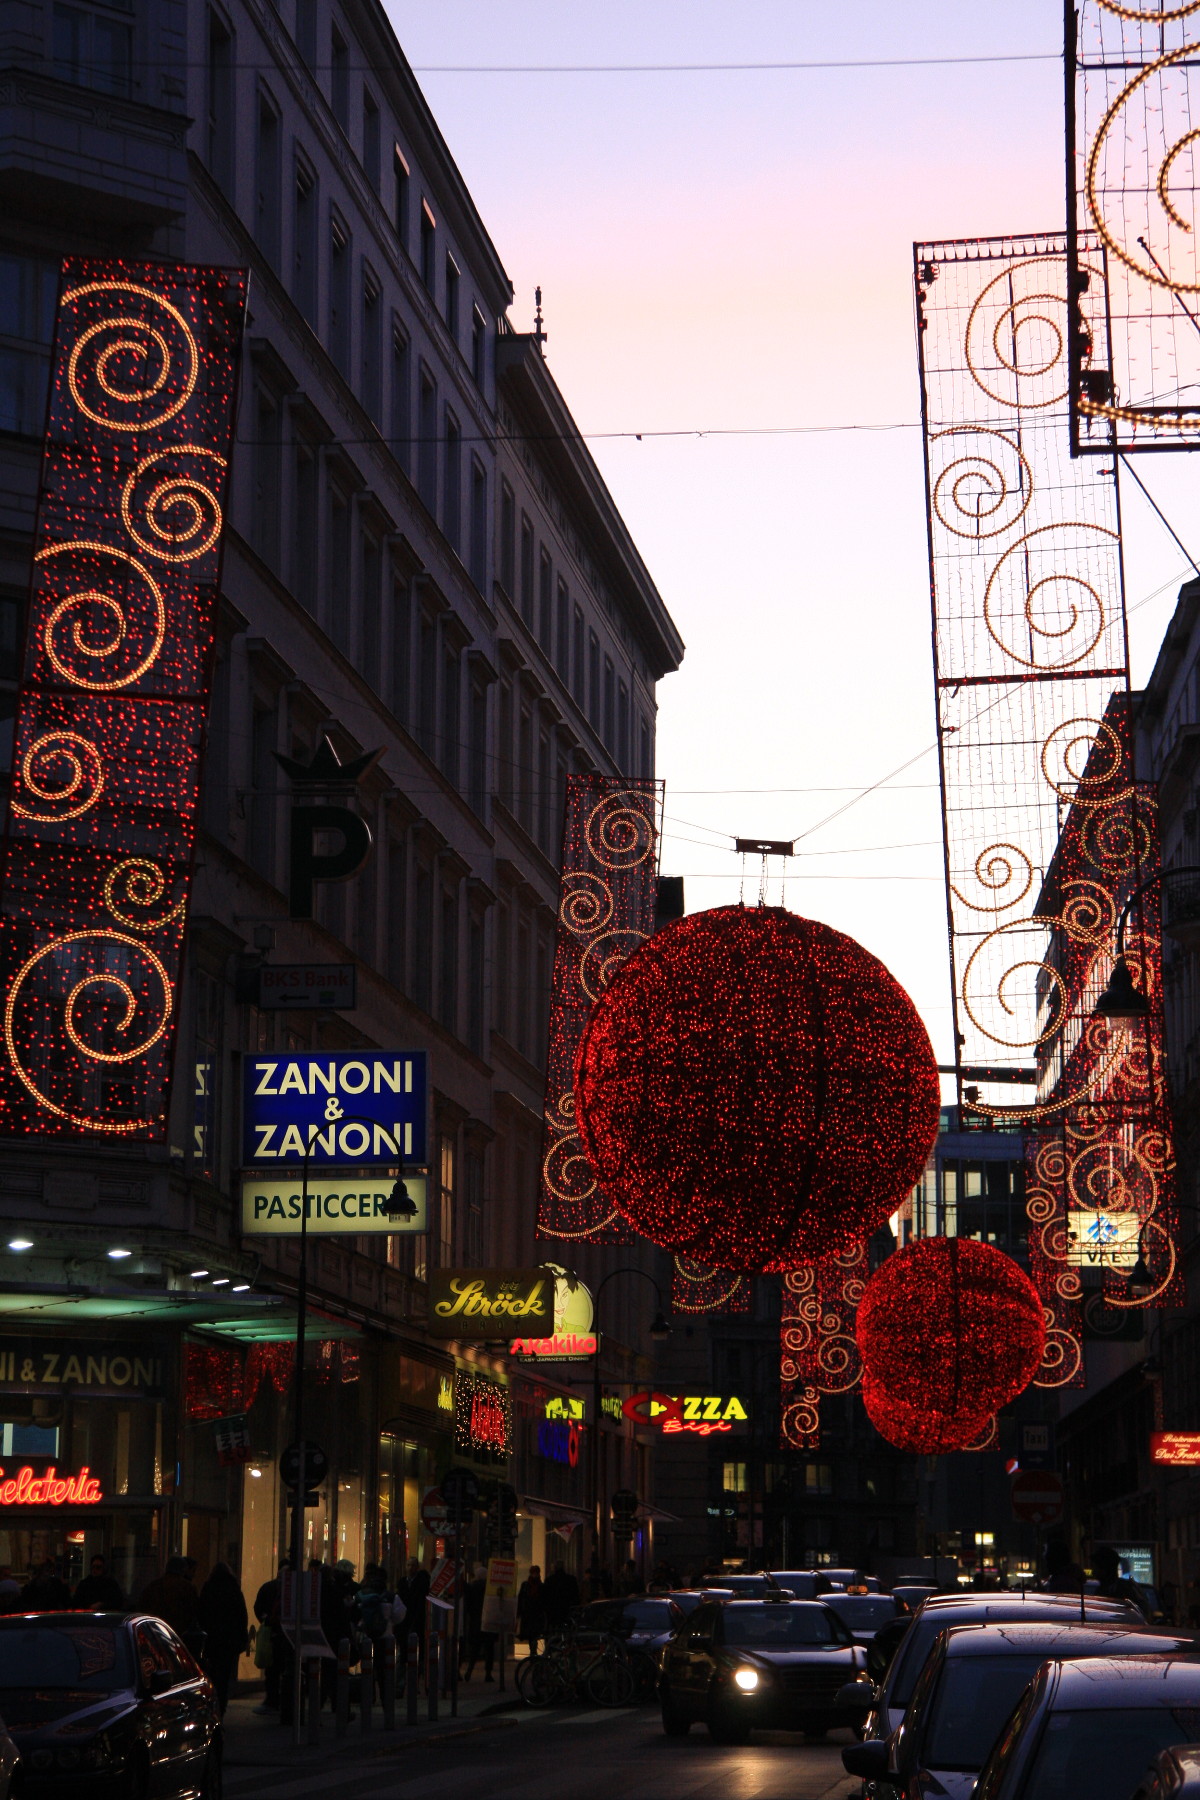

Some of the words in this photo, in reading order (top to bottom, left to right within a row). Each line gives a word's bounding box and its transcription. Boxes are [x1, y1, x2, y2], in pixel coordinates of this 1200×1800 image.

[263, 971, 300, 988] BKS
[305, 970, 349, 987] Bank
[254, 1060, 413, 1095] ZANONI
[324, 1096, 345, 1120] &
[254, 1122, 413, 1157] ZANONI
[254, 1193, 416, 1219] PASTICCER
[434, 1277, 546, 1318] Ströck
[19, 1358, 37, 1383] &
[41, 1353, 162, 1387] ZANONI
[650, 1396, 748, 1420] PZZA
[1025, 1431, 1046, 1444] Taxi
